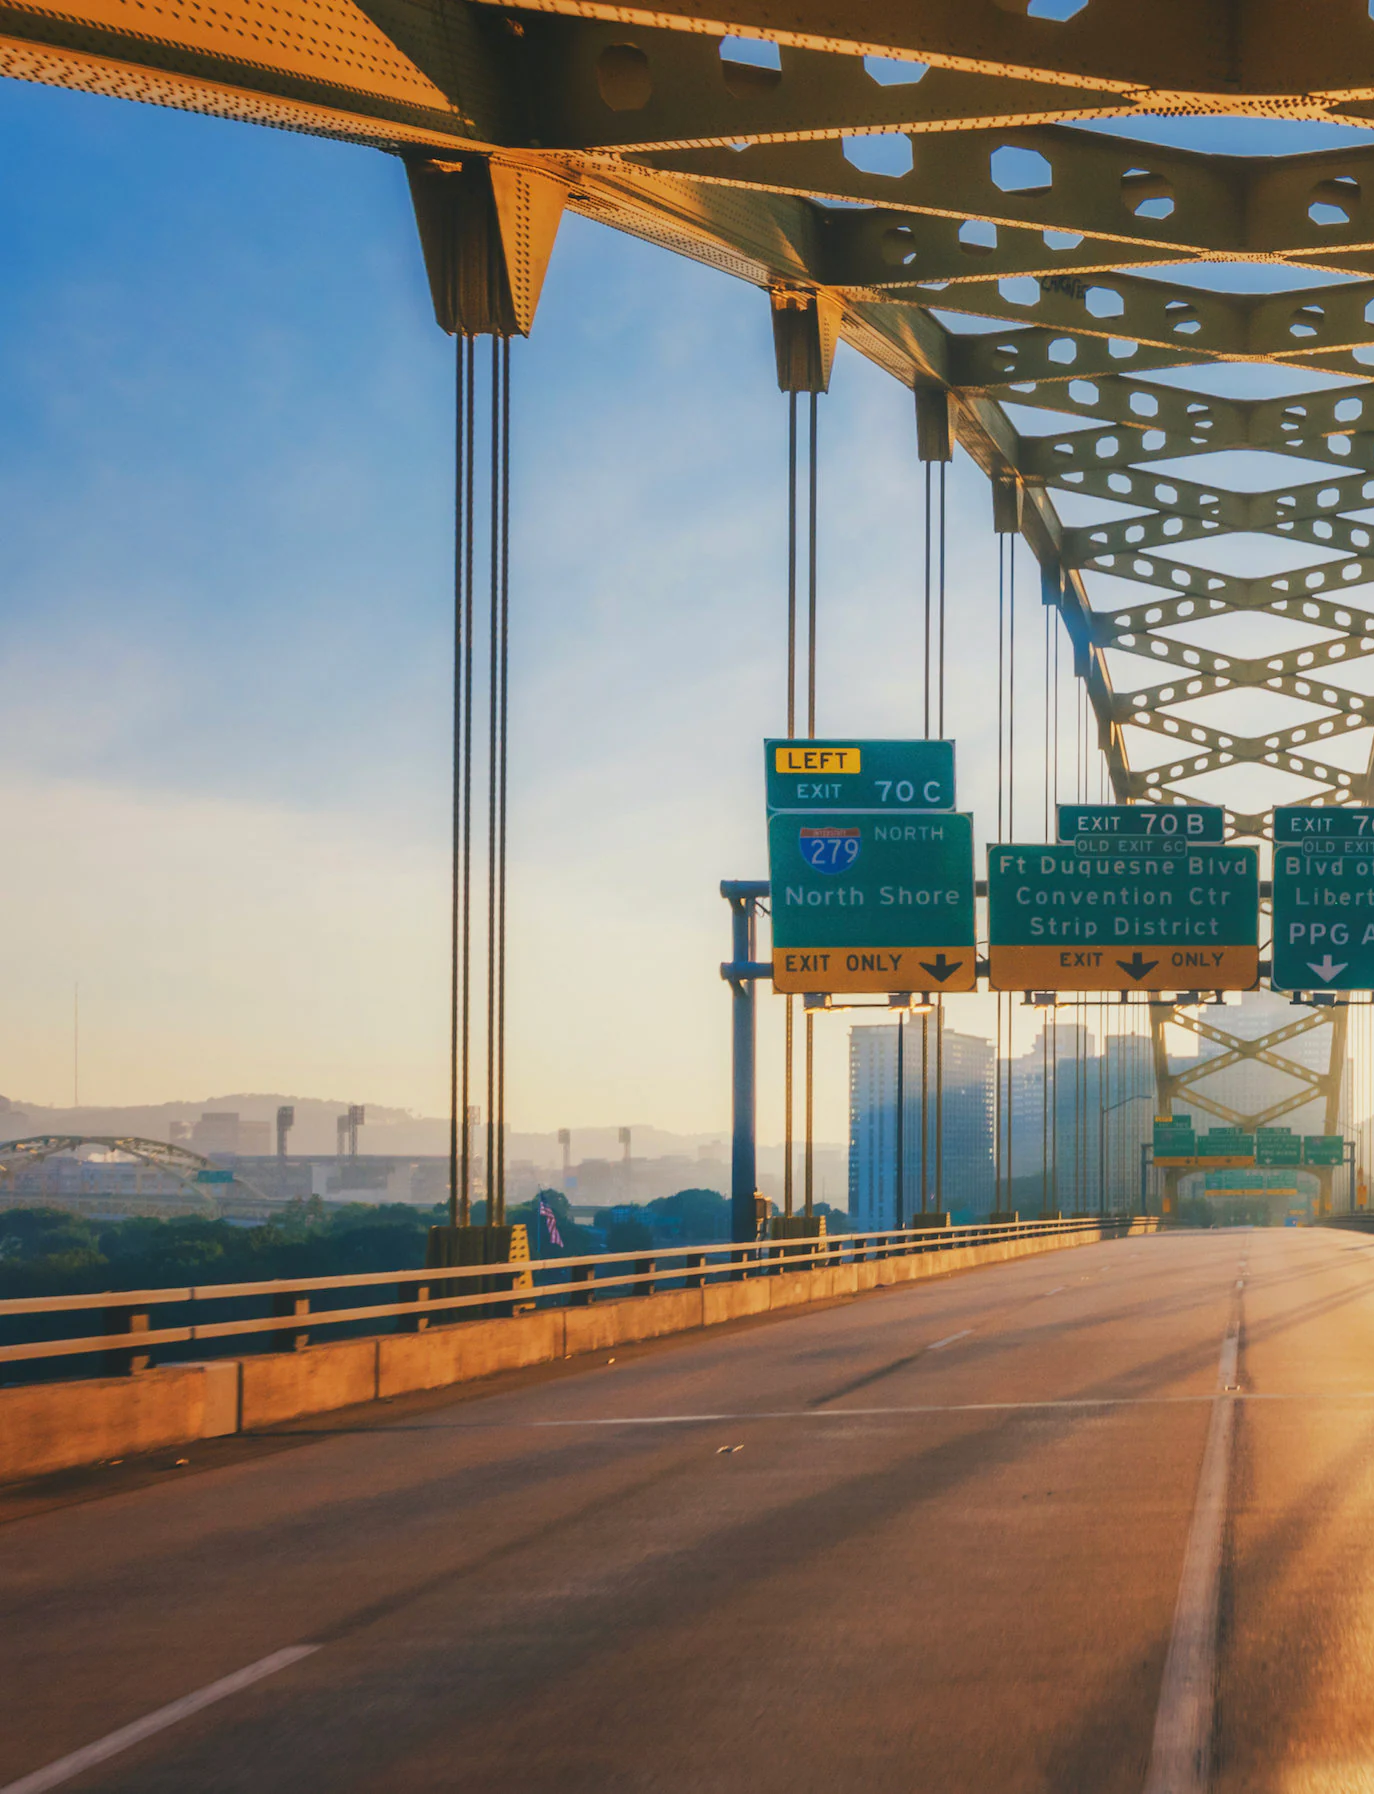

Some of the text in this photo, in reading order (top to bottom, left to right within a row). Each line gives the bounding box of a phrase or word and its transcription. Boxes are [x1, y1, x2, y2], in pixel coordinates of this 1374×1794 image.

[788, 752, 848, 769] LEFT
[797, 783, 842, 799] EXIT
[1078, 816, 1121, 831] EXIT
[1291, 817, 1333, 832] EXIT
[875, 826, 944, 841] NORTH
[811, 839, 859, 865] 279
[1078, 840, 1109, 852] OLD
[1119, 840, 1151, 852] EXIT
[1304, 841, 1335, 853] OLD
[1000, 856, 1248, 878] Ft Duquesne Blvd
[1286, 857, 1343, 876] Blvd
[785, 886, 960, 906] North Shore
[1016, 887, 1231, 905] Convention Ctr
[1030, 917, 1219, 938] Strip District
[1289, 922, 1349, 945] PPG
[785, 954, 903, 972] EXIT ONLY
[1060, 952, 1225, 967] EXIT ONLY
